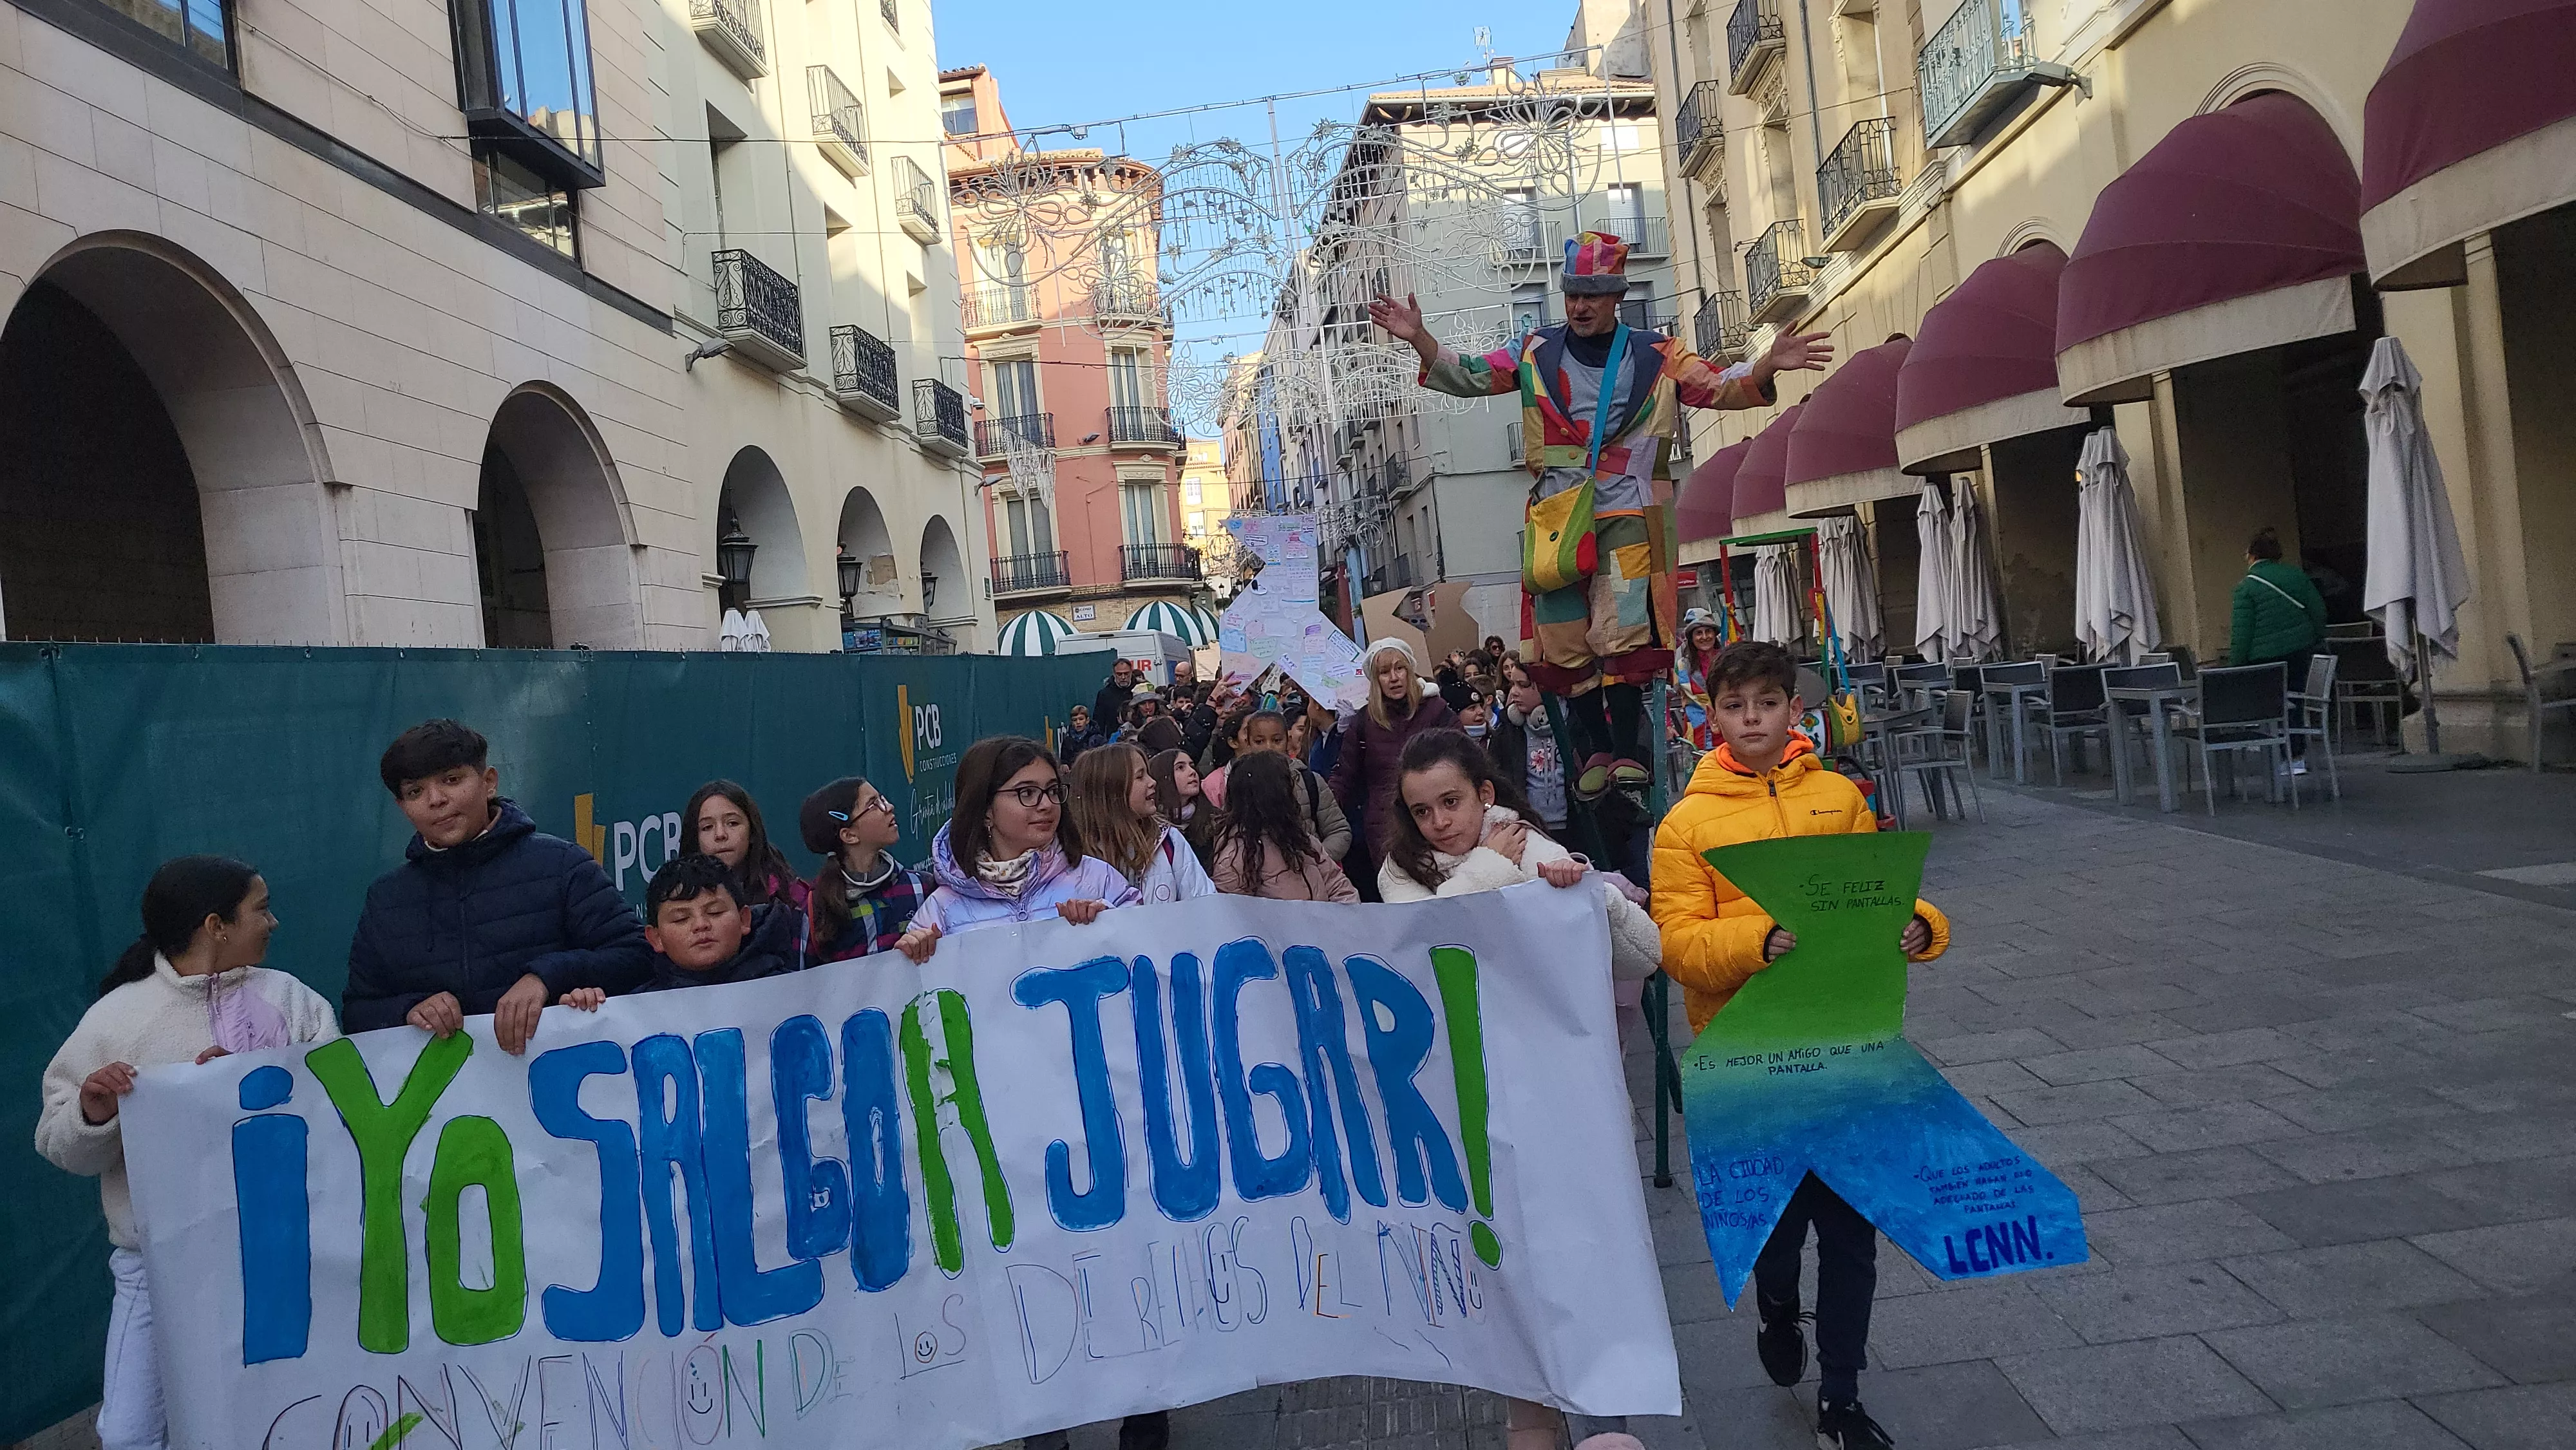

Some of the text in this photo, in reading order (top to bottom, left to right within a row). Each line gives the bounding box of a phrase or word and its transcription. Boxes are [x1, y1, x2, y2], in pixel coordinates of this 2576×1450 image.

[914, 704, 942, 750] PCB
[919, 752, 957, 772] CONSTRUCCIONES
[1842, 880, 1886, 894] FELIZ
[1811, 896, 1904, 912] SIN PANTALLAS.
[1768, 1051, 1783, 1064] UN
[1830, 1044, 1852, 1056] QUE
[1861, 1041, 1884, 1053] UNA
[1768, 1062, 1828, 1075] PANTALLA.
[528, 1006, 911, 1344] SALGO
[899, 988, 1015, 1280] A
[1009, 936, 1502, 1270] JUGAR!
[1696, 1156, 1785, 1186] LA CIUDAD
[1951, 1165, 1970, 1176] LOS
[1978, 1155, 2021, 1171] ADULTOS
[1701, 1187, 1769, 1209] DE LOS
[1993, 1187, 2007, 1198] DE
[2014, 1183, 2034, 1194] LAS
[1943, 1214, 2054, 1274] LCNN.
[789, 1328, 855, 1420] DE
[1291, 1216, 1363, 1319] DEL
